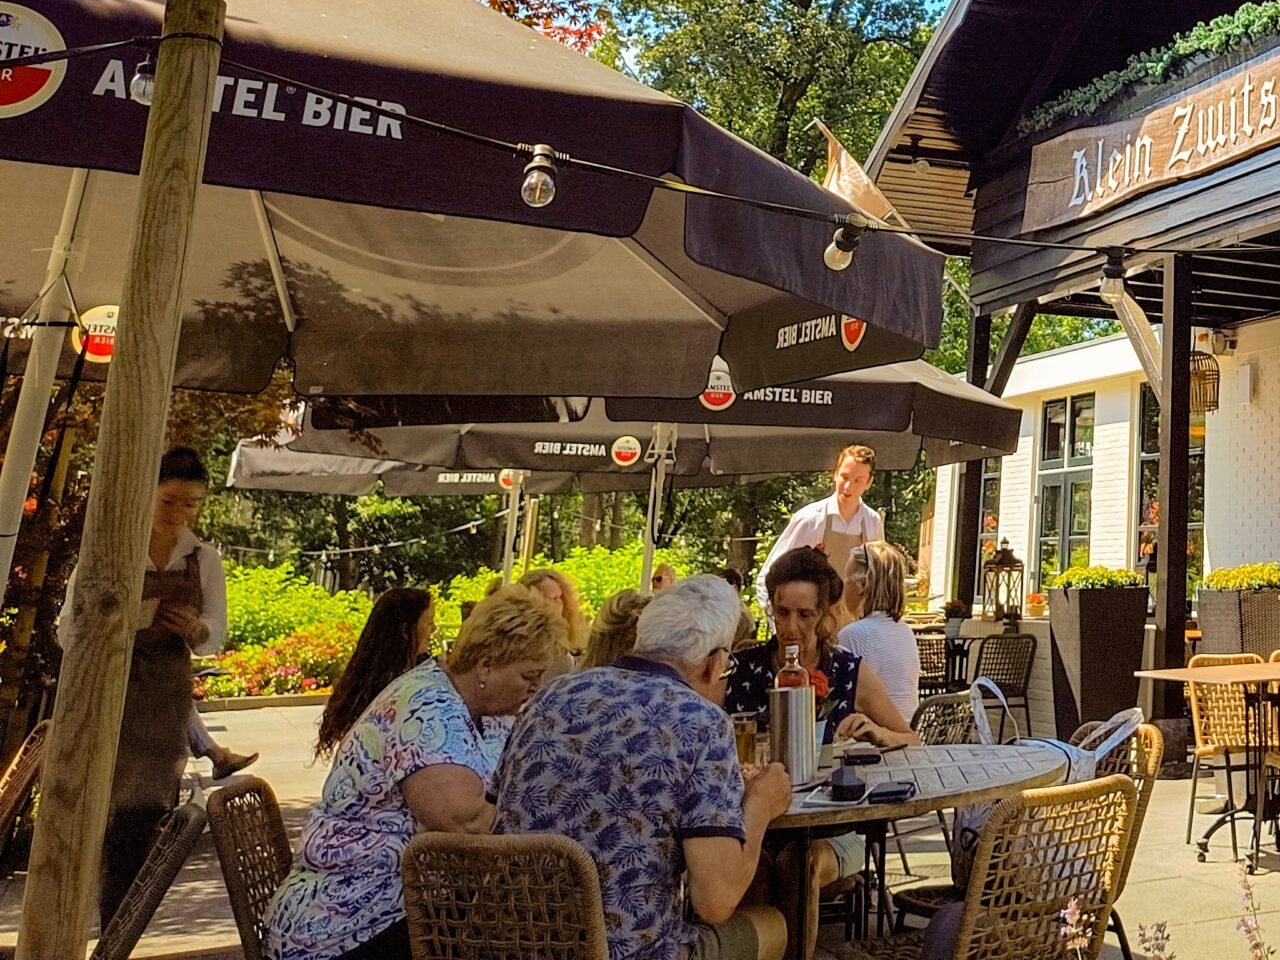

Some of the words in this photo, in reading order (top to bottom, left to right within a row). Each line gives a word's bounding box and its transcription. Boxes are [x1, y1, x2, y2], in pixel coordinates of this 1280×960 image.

[92, 58, 286, 122] ATEL
[301, 93, 407, 139] BIER
[1068, 133, 1155, 208] Klein
[743, 387, 799, 403] AMSTEL
[801, 390, 833, 404] BIER
